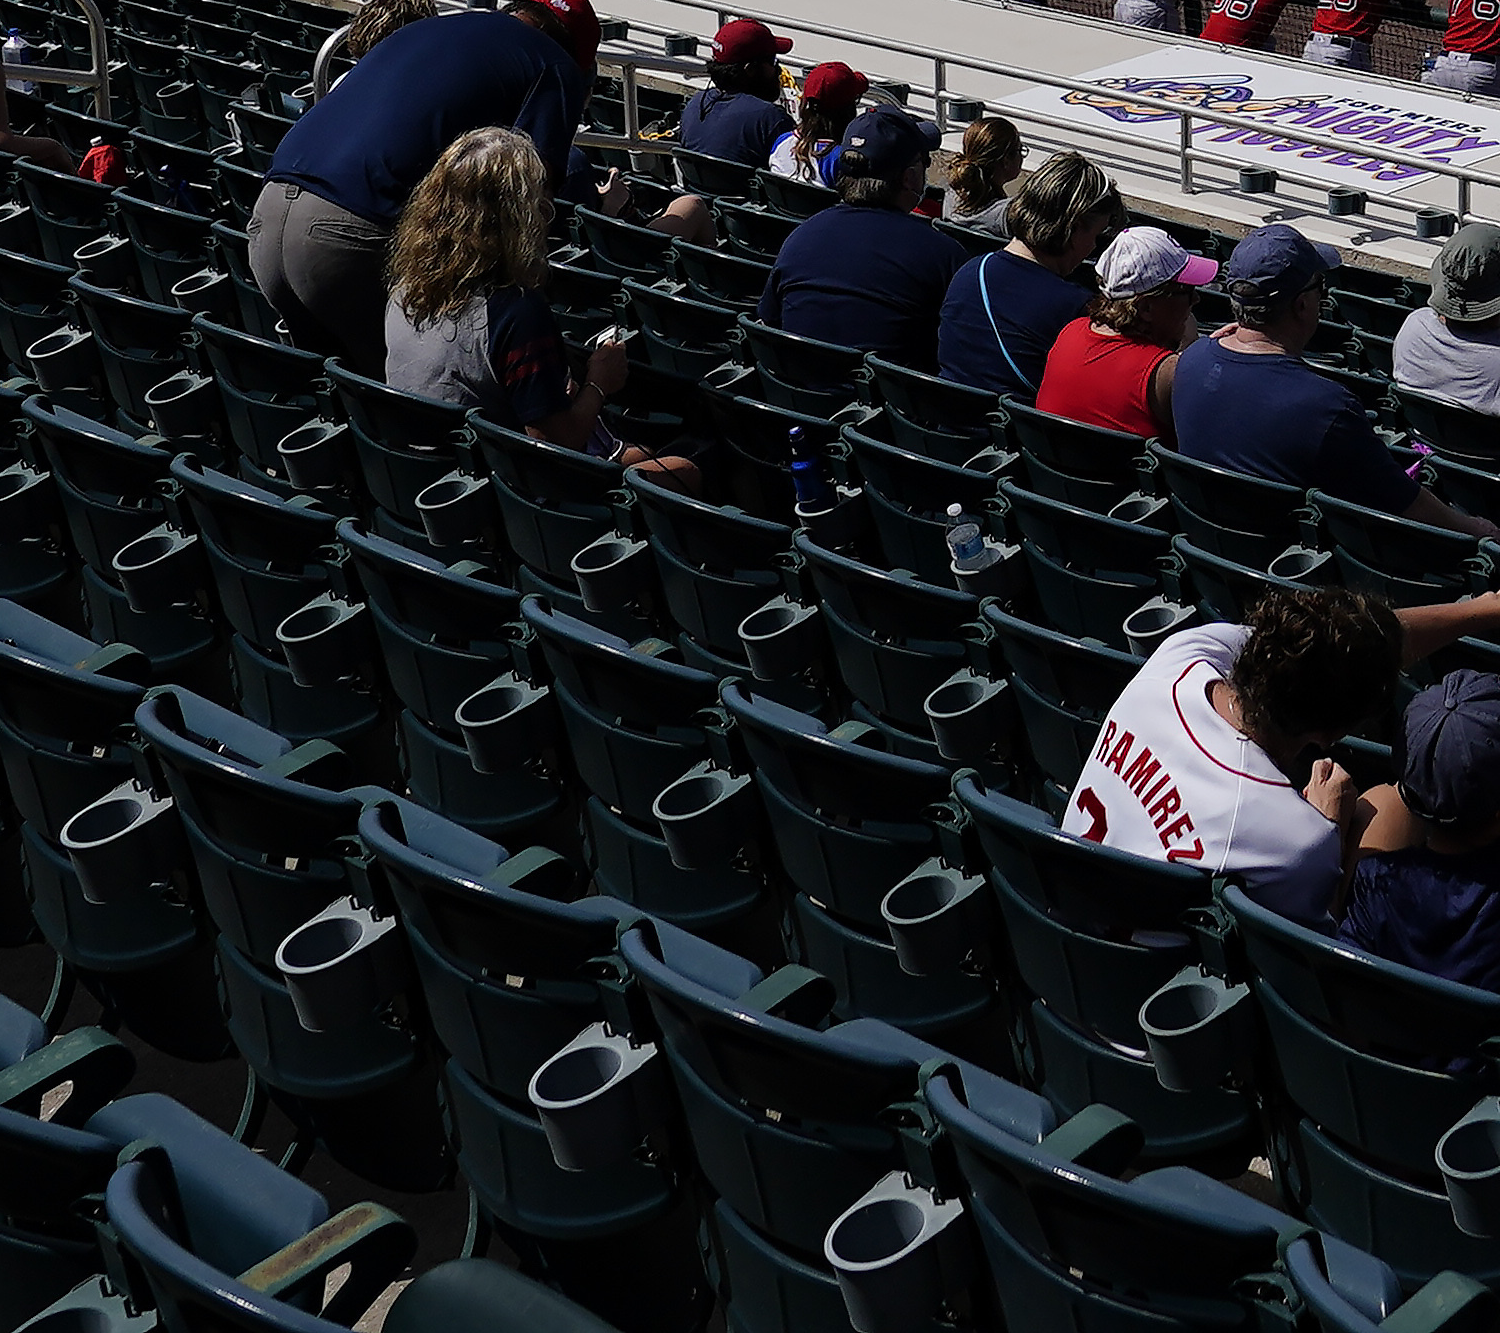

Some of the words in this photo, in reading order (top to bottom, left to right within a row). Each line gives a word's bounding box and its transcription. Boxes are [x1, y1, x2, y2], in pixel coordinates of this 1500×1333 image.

[1264, 102, 1499, 156] MIGHTY
[1334, 97, 1399, 116] FORT
[1401, 112, 1487, 135] MYERS
[1095, 720, 1205, 864] RAMIREZ
